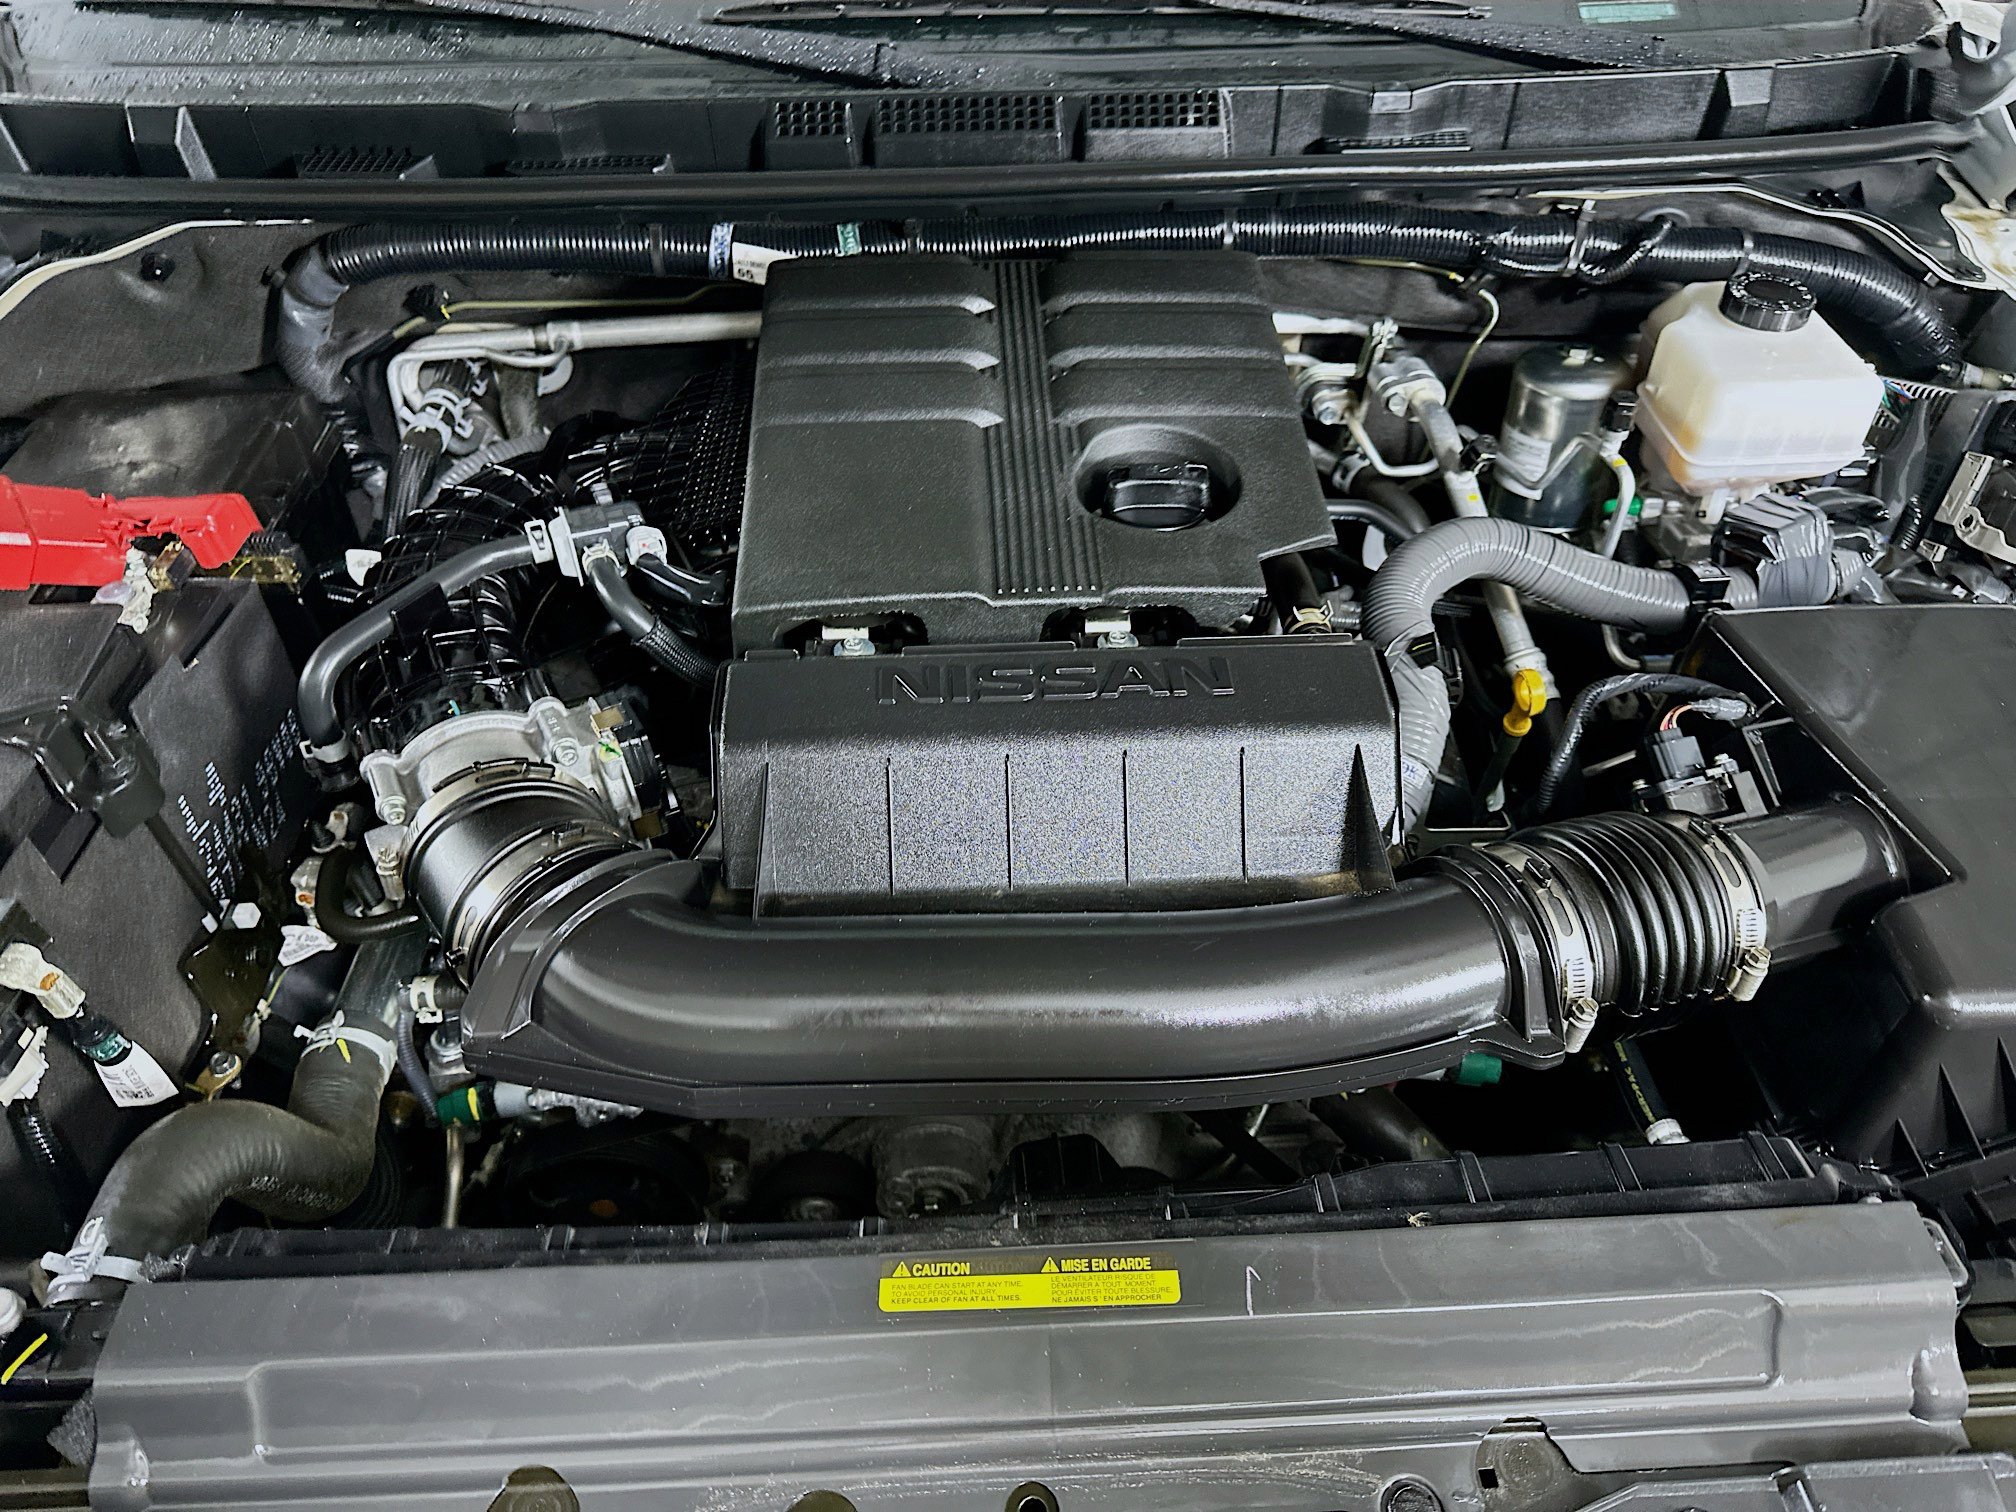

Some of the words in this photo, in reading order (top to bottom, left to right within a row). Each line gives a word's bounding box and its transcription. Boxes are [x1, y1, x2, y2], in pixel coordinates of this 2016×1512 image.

[878, 657, 1235, 705] NISSAN
[912, 1262, 971, 1277] CAUTION
[1060, 1258, 1090, 1272] MISE
[1091, 1258, 1109, 1271] EN
[1110, 1257, 1152, 1271] GARDE
[934, 1282, 949, 1290] CAN
[987, 1280, 1003, 1288] ANY
[1104, 1287, 1128, 1295] TOUTE
[891, 1297, 911, 1305] KEEP
[1063, 1295, 1092, 1303] JAMAIS
[1115, 1293, 1162, 1302] APPROCHER
